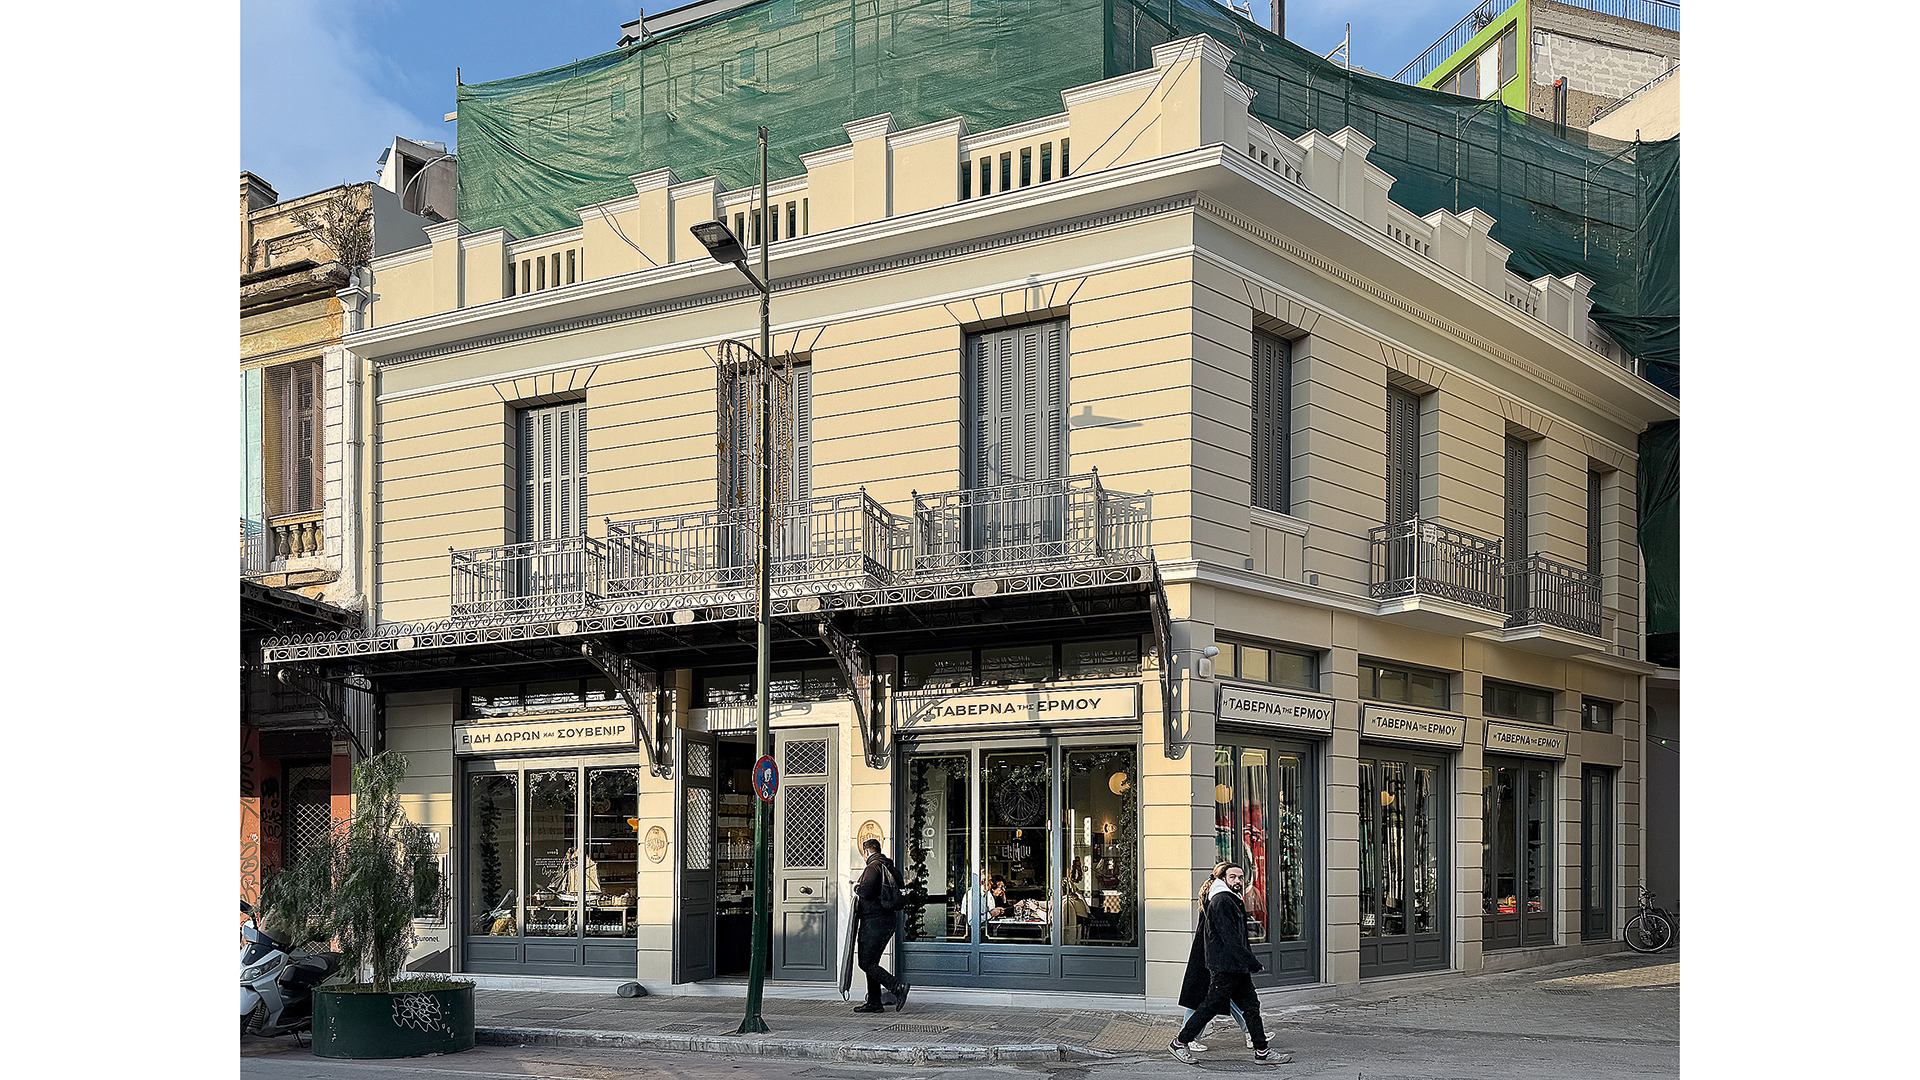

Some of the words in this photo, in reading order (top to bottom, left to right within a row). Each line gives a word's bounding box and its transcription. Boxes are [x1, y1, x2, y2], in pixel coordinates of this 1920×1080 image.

[935, 703, 1016, 717] ΤΑΒΕΡΝΑ
[1036, 698, 1101, 713] ΕΡΜΟΥ
[1229, 698, 1281, 715] ΤΑΒΕΡΝΑ
[1293, 707, 1331, 720] ΕΡΜΟΥ
[462, 734, 491, 744] ΕΙΔΗ
[494, 731, 540, 742] ΔΩΡΩΝ
[557, 725, 626, 739] ΣΟΥΒΕΝΙΡ
[1376, 717, 1418, 731] ΤΑΒΕΡΝΑ
[1427, 724, 1457, 736] ΕΡΜΟΥ
[1497, 732, 1530, 745] ΤΑΒΕΡΝΑ
[1537, 738, 1561, 748] ΕΡΜΟΥ
